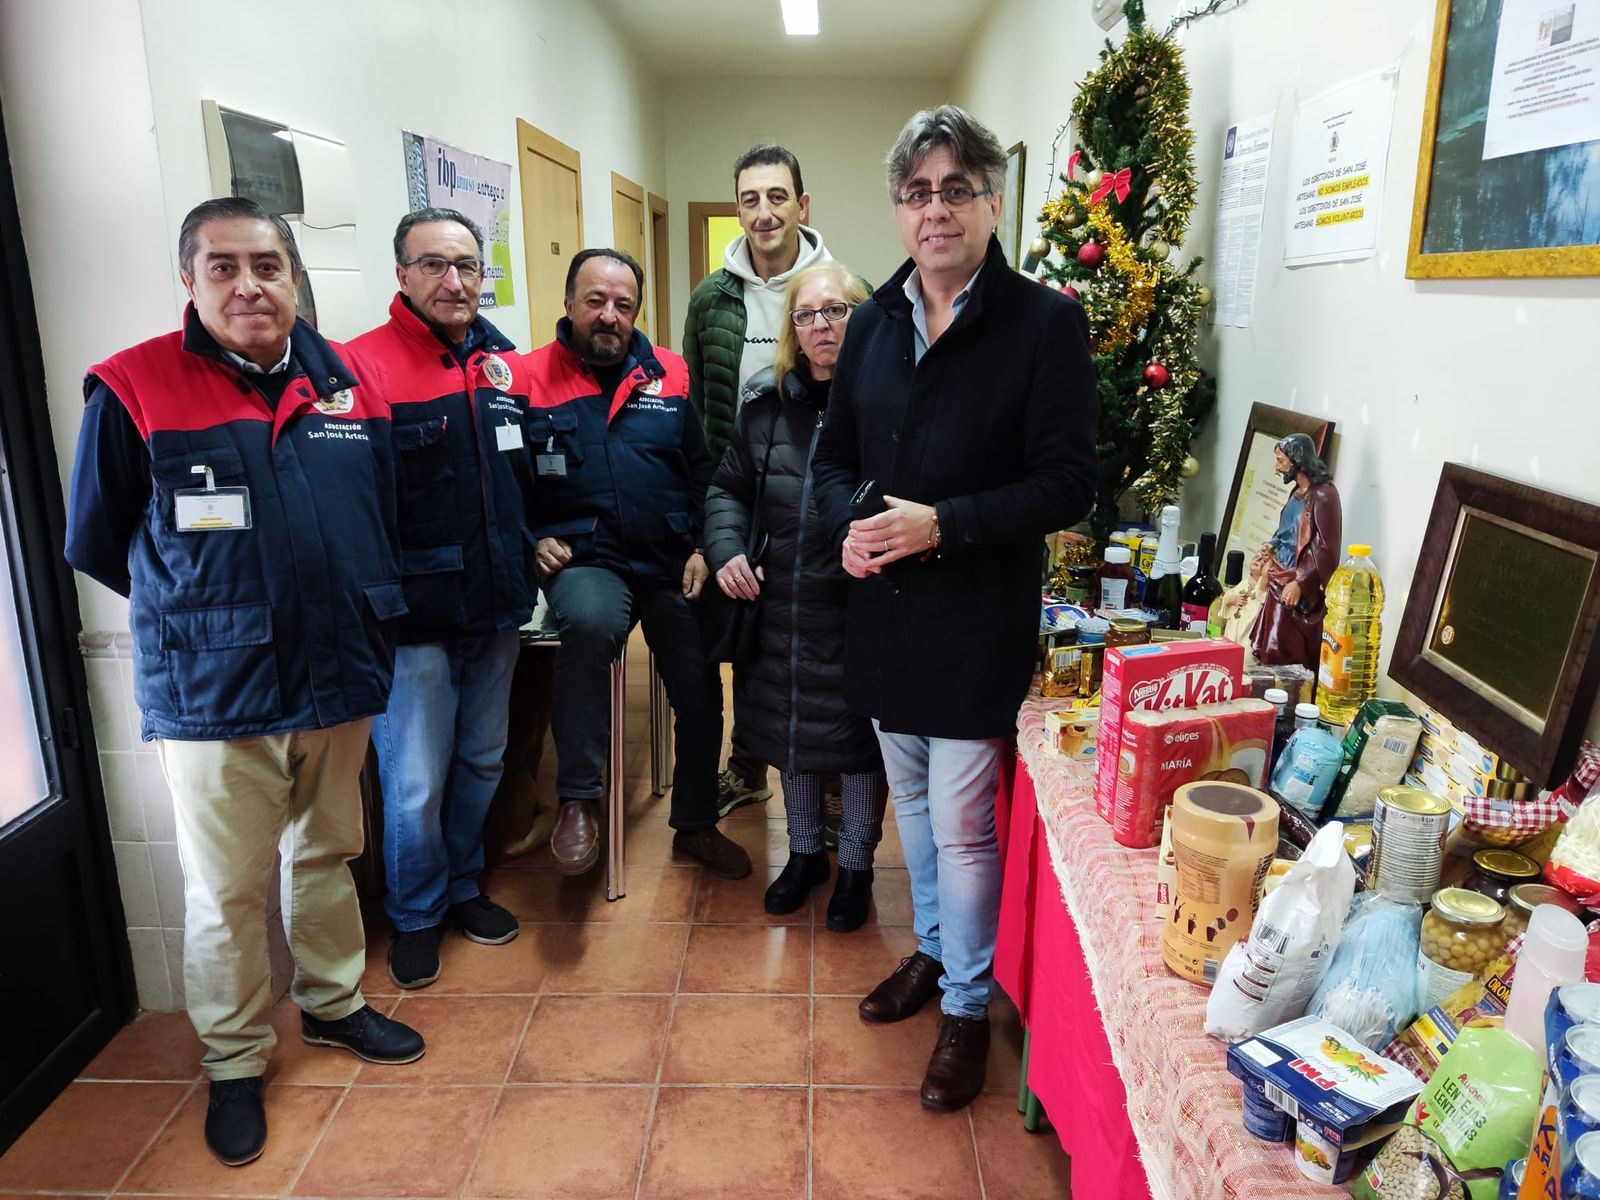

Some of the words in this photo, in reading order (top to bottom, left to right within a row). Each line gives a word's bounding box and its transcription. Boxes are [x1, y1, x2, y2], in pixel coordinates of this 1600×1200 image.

[438, 147, 456, 197] ibp
[477, 181, 500, 209] entrega
[501, 188, 505, 200] a
[1302, 176, 1311, 187] LOS
[1342, 164, 1354, 175] SAN
[1353, 160, 1367, 173] JOSÉ
[1296, 189, 1316, 202] ARTESANO
[1324, 183, 1342, 195] SOMOS
[1341, 175, 1369, 192] EMPLEADOS
[1298, 206, 1307, 216] LOS
[1339, 196, 1350, 207] SAN
[1350, 192, 1363, 204] JOSÉ
[1293, 218, 1314, 230] ARTESANO
[1315, 214, 1332, 226] SOMOS
[1332, 207, 1365, 223] VOLUNTARIOS
[639, 402, 652, 410] José
[307, 431, 326, 440] San
[326, 430, 344, 440] José
[324, 422, 362, 431] ASOCIACIÓN
[1133, 683, 1159, 698] Nestlé
[1174, 731, 1200, 743] eliges
[1160, 757, 1192, 770] MARÍA
[1288, 1059, 1338, 1091] PMI
[1457, 1073, 1488, 1108] Auchan
[1442, 1077, 1487, 1129] LENTEJAS
